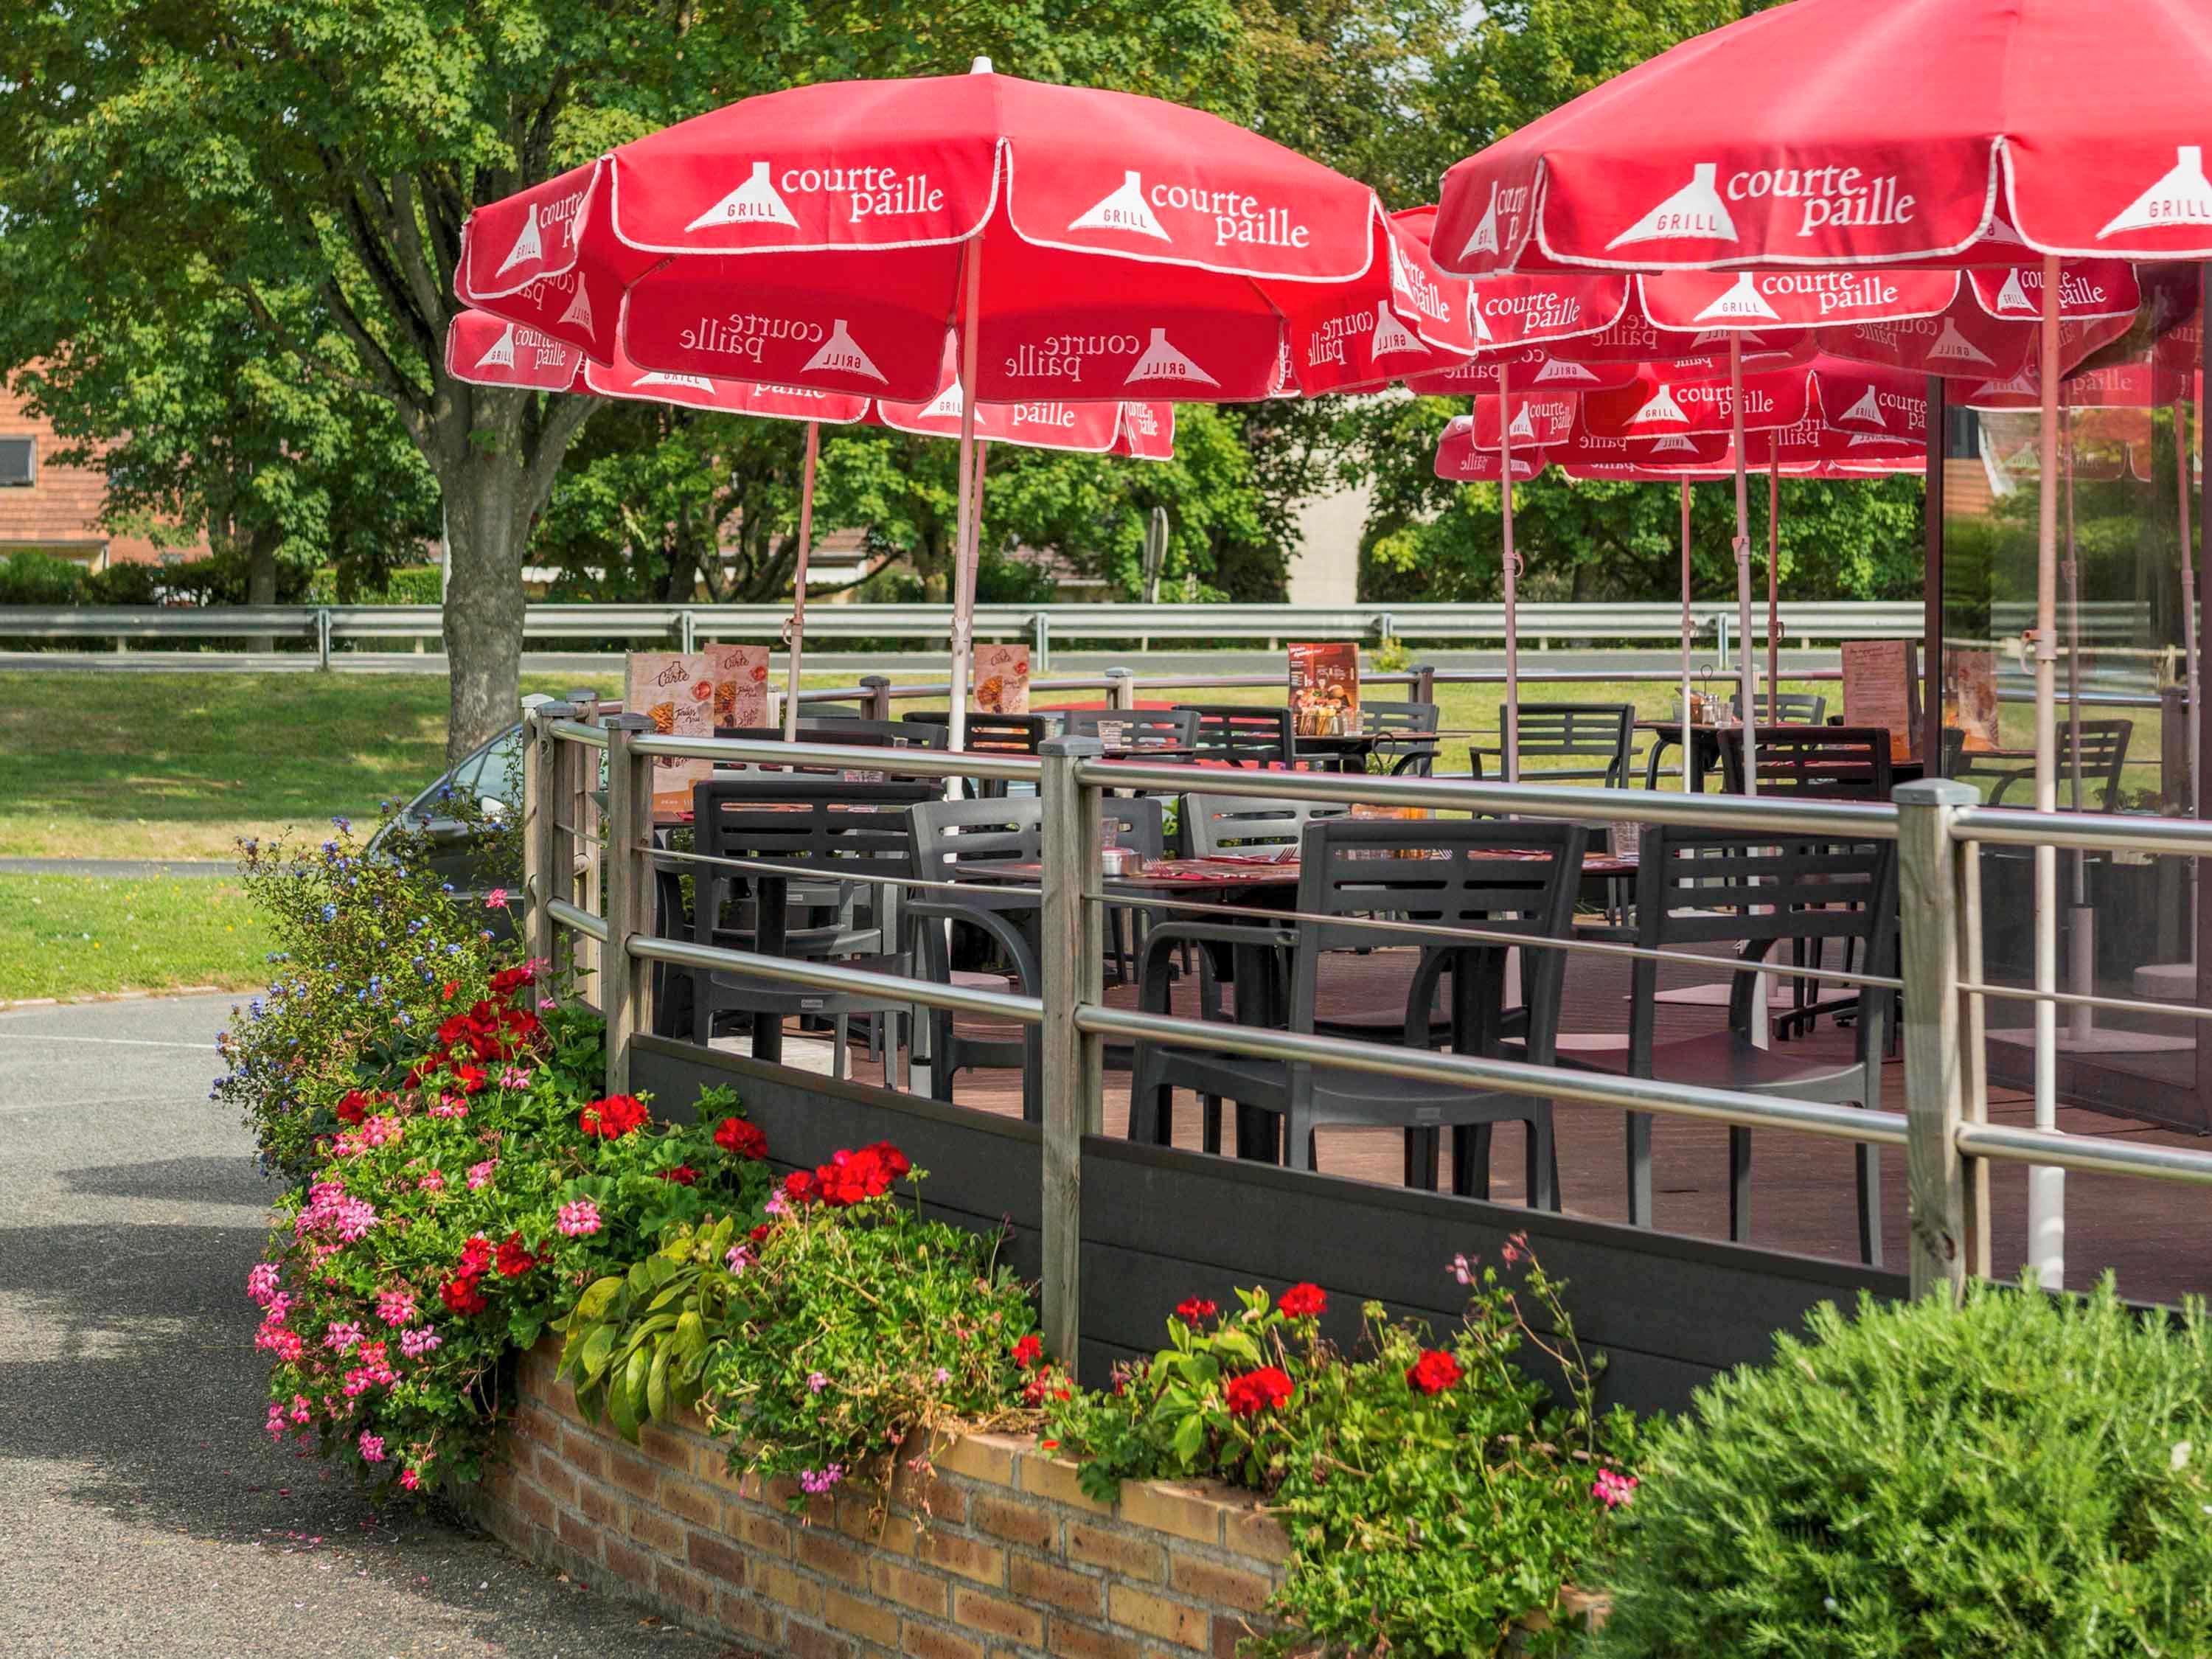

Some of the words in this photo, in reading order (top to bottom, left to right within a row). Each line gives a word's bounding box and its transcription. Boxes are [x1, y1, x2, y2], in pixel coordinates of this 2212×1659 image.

[782, 166, 897, 192] courte
[1727, 164, 1862, 201] courte
[727, 202, 776, 218] GRILL
[849, 175, 944, 223] paille
[1151, 184, 1258, 219] courte
[1796, 175, 1916, 237] paille
[2149, 200, 2211, 218] GRILL
[1103, 209, 1147, 229] GRILL
[1214, 207, 1310, 248] paille
[1657, 214, 1718, 231] GRILL
[1762, 271, 1854, 295] courte
[1485, 292, 1559, 316] courte
[1818, 276, 1899, 315] paille
[1523, 296, 1582, 335] paille
[1722, 302, 1760, 313] GRILL
[490, 350, 512, 361] GRILL
[533, 342, 566, 370] paille
[1677, 386, 1745, 403] court
[1719, 389, 1775, 420] pille
[1879, 392, 1927, 414] courte
[939, 401, 962, 413] GRIL
[1013, 402, 1075, 428] paille
[1529, 401, 1565, 418] courte
[1645, 408, 1675, 418] GRILL
[1855, 406, 1877, 420] GRILL
[656, 670, 690, 688] Carte
